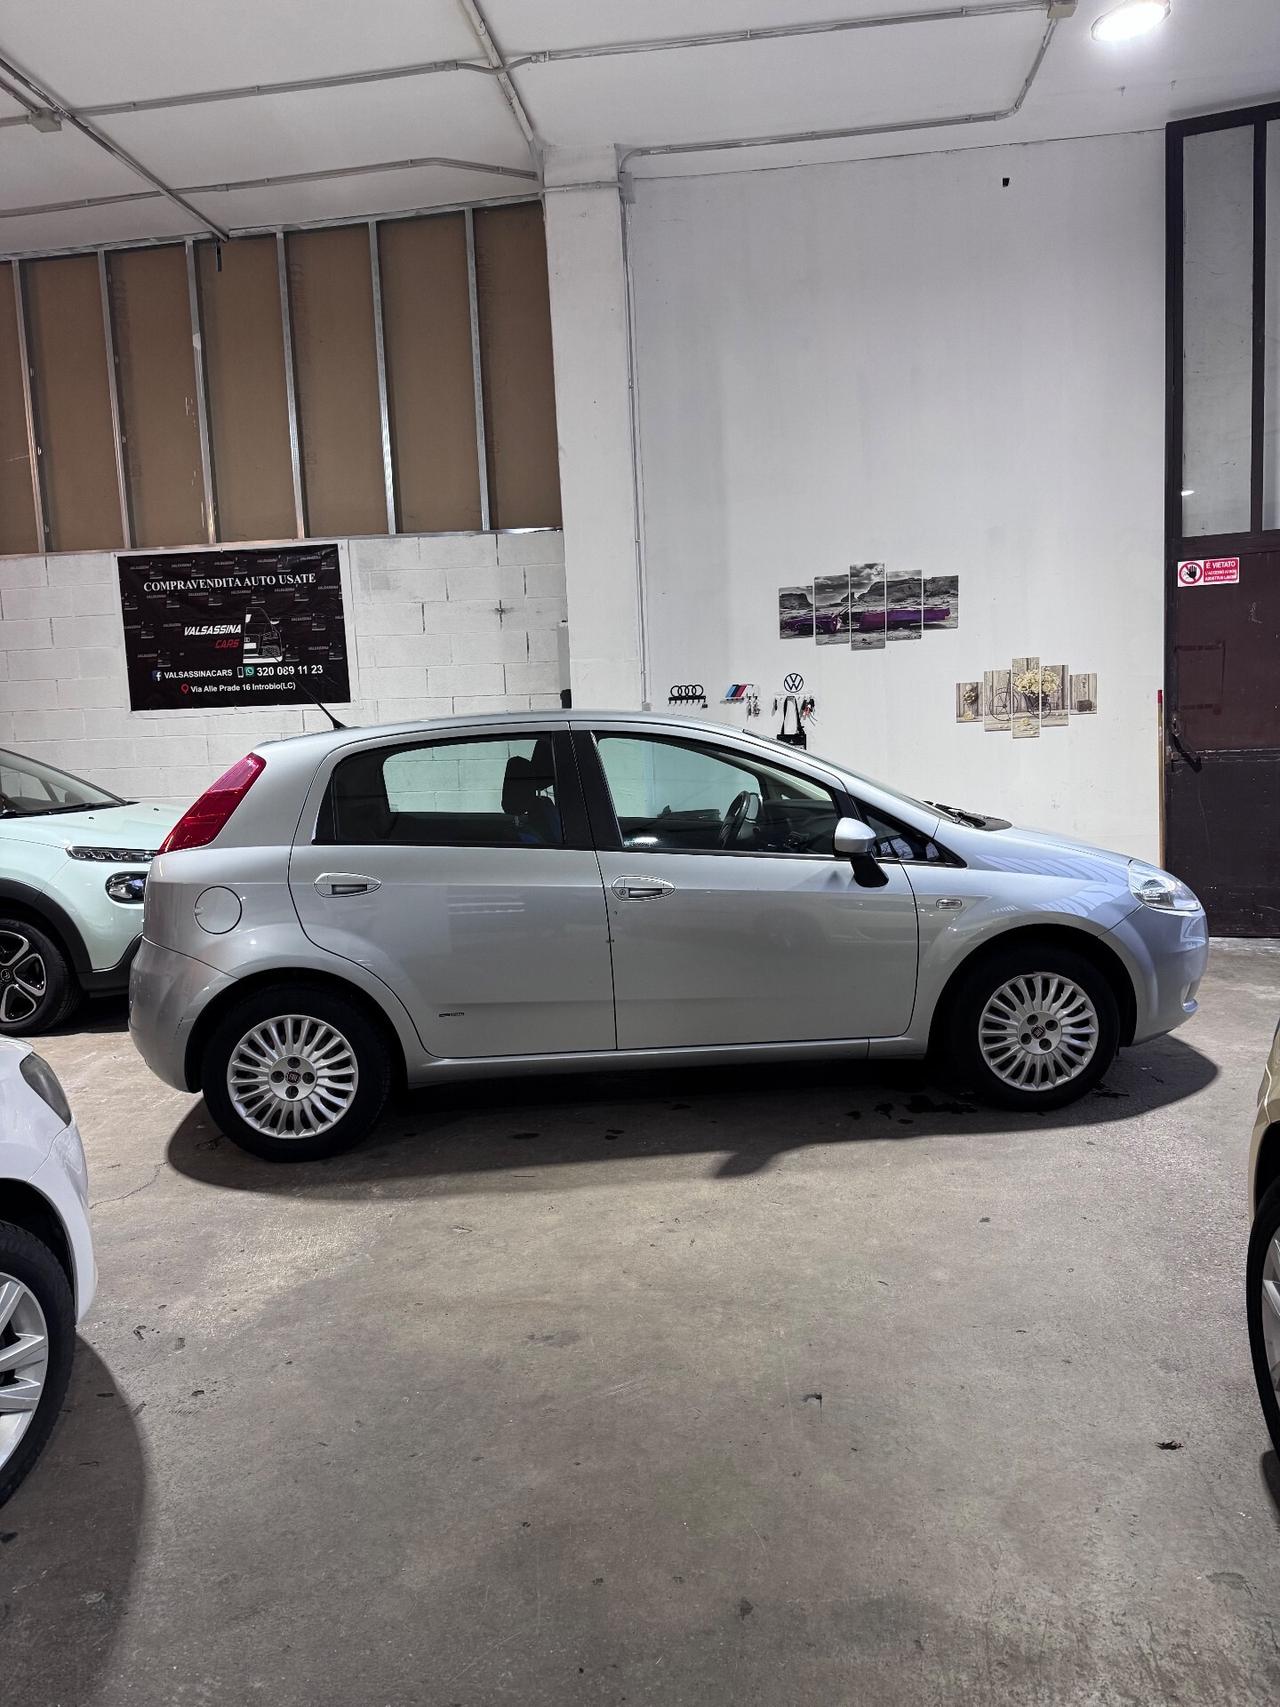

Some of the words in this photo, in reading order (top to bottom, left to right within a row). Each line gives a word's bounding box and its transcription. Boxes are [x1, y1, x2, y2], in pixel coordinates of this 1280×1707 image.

[1212, 561, 1236, 569] VIETATO
[143, 577, 242, 592] COMPRAVENDITA
[243, 575, 276, 587] AUTO
[278, 573, 317, 585] USATE
[184, 624, 241, 636] VALSASSINA
[214, 639, 240, 649] CARS
[164, 669, 233, 679] VALSASSINACARS
[256, 667, 275, 677] 320
[297, 665, 308, 675] 11
[311, 664, 323, 674] 23
[190, 685, 202, 693] Via
[219, 683, 241, 692] Prade
[242, 683, 251, 691] 16
